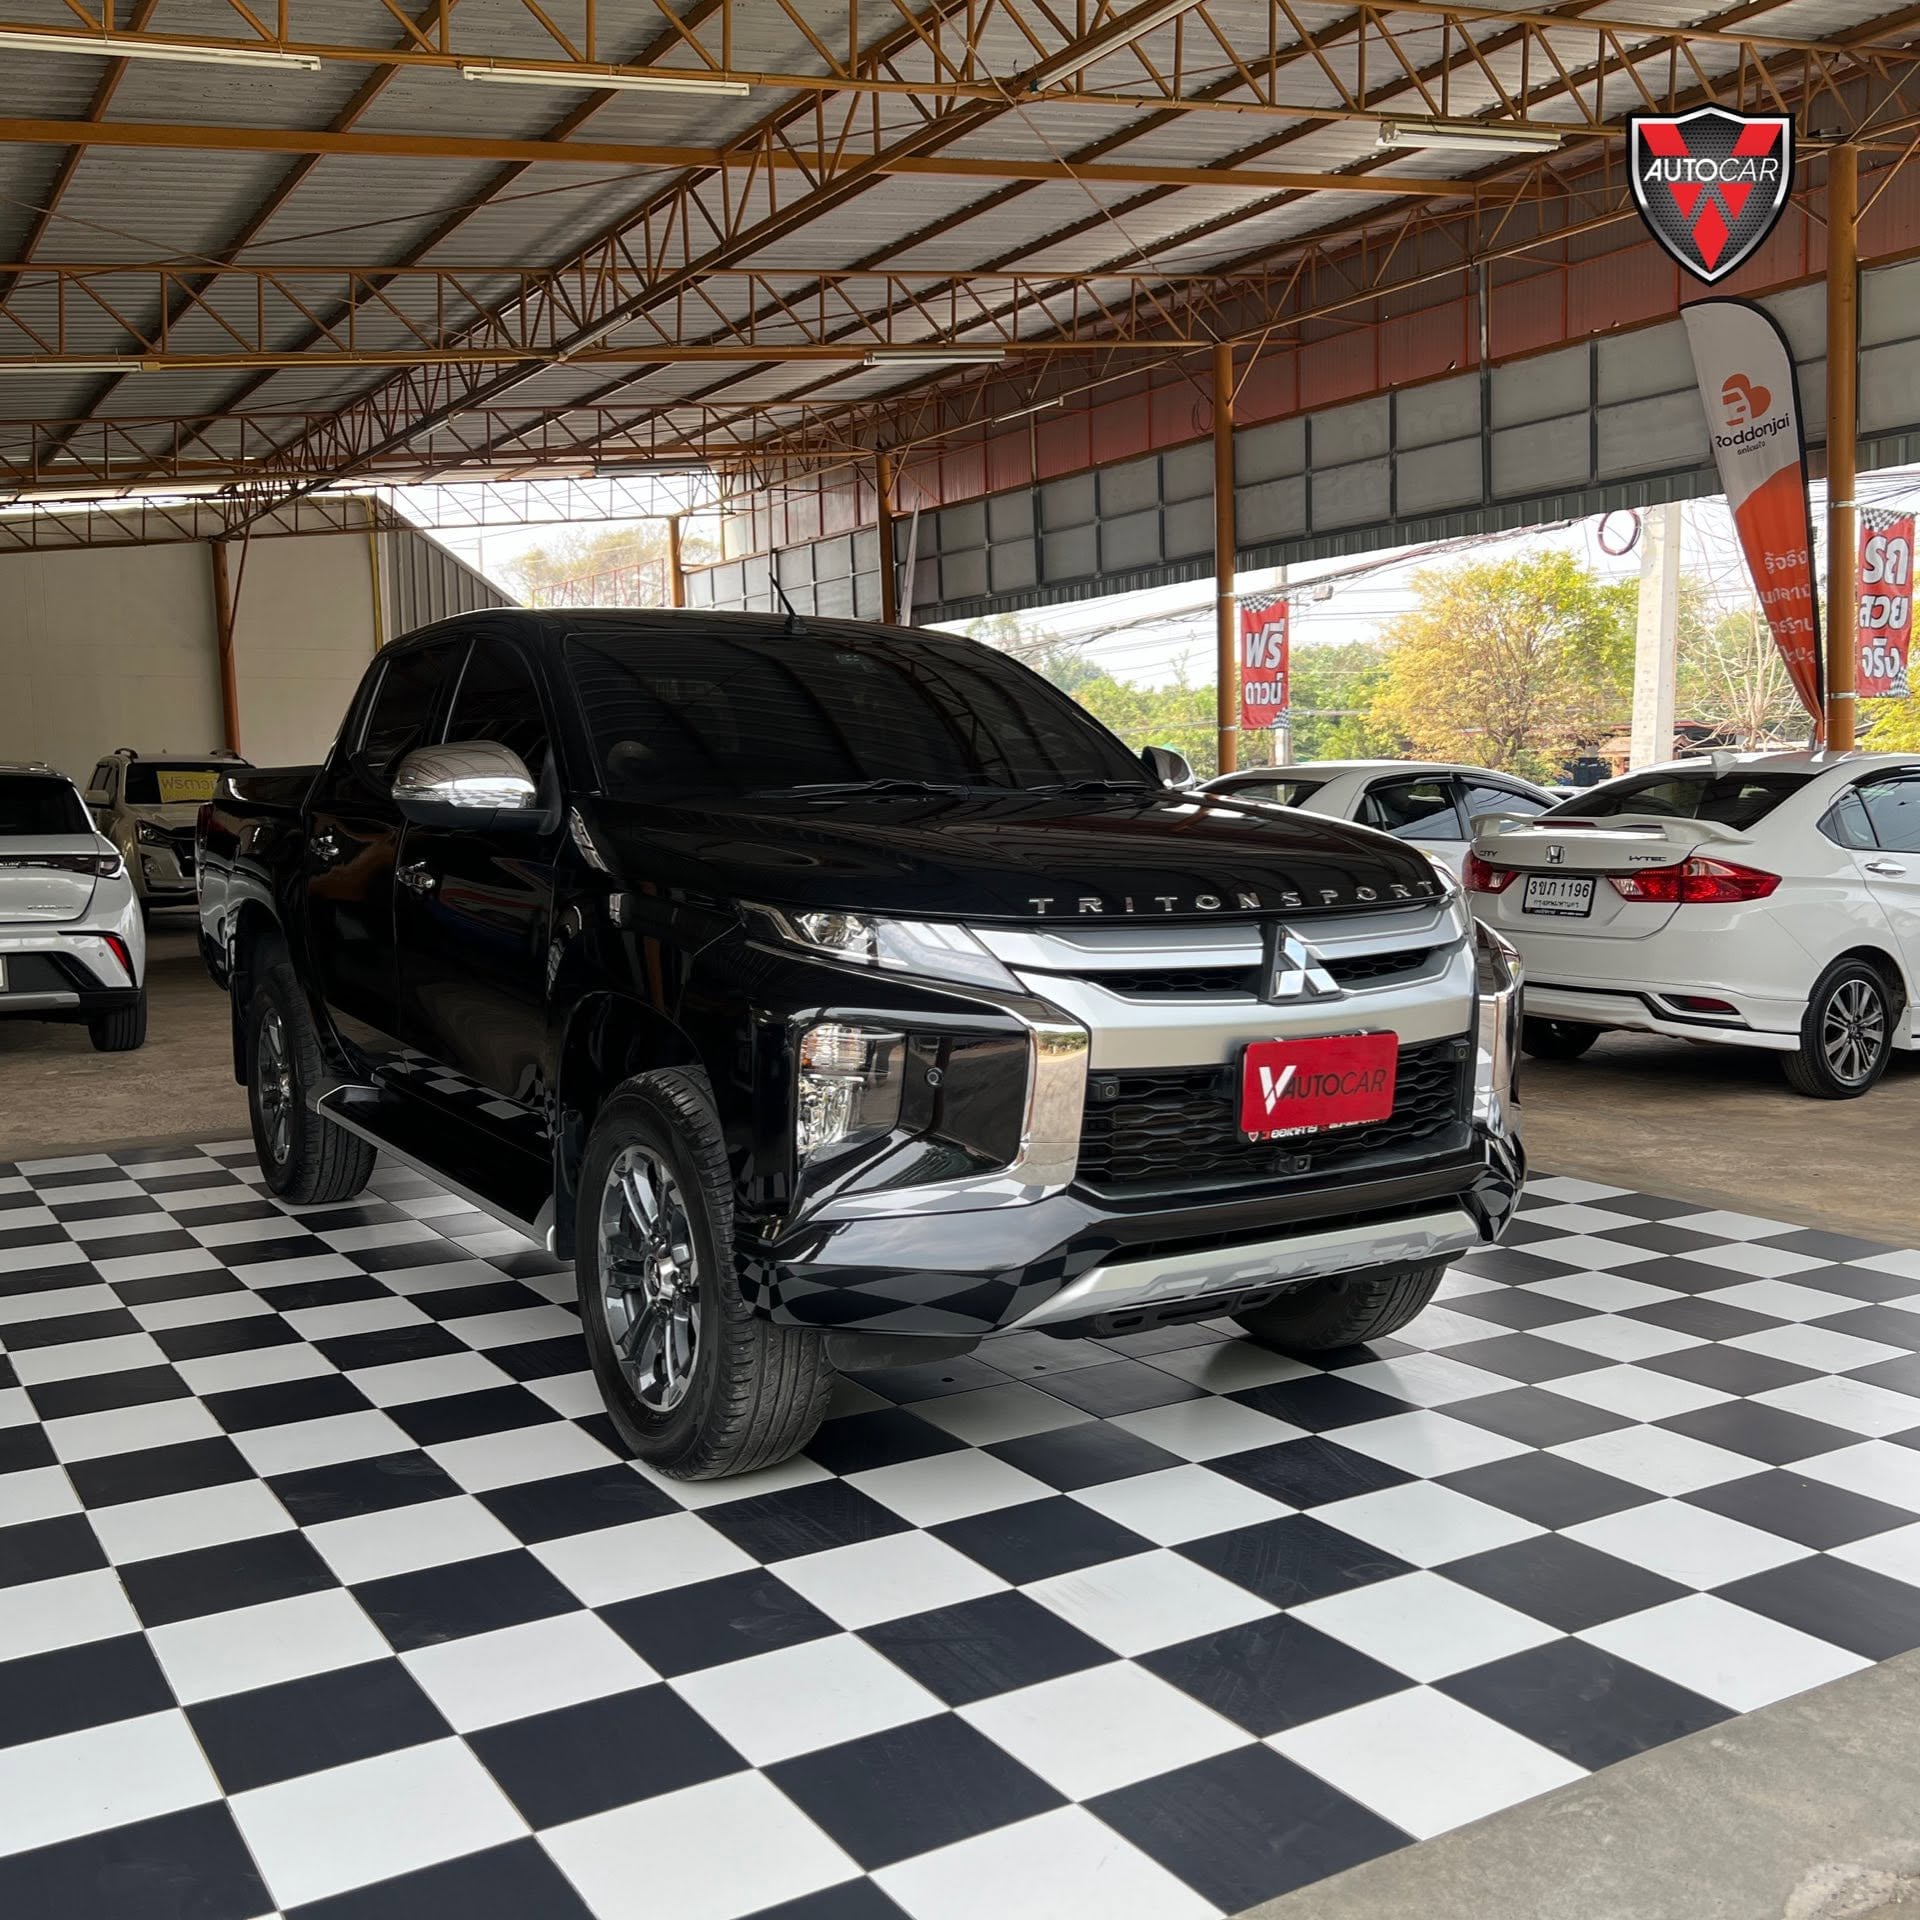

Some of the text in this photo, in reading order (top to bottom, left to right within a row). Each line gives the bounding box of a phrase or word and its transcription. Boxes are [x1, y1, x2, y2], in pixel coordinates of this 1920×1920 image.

[1715, 413, 1790, 448] Roddonjai
[1862, 535, 1909, 585] รถ
[1859, 594, 1909, 629] สวย
[1245, 618, 1286, 669] ฟรี
[1862, 636, 1900, 678] จริง
[1245, 672, 1285, 705] ดาวน์
[1560, 882, 1590, 898] 1196
[1280, 1068, 1387, 1100] AUTOCAR
